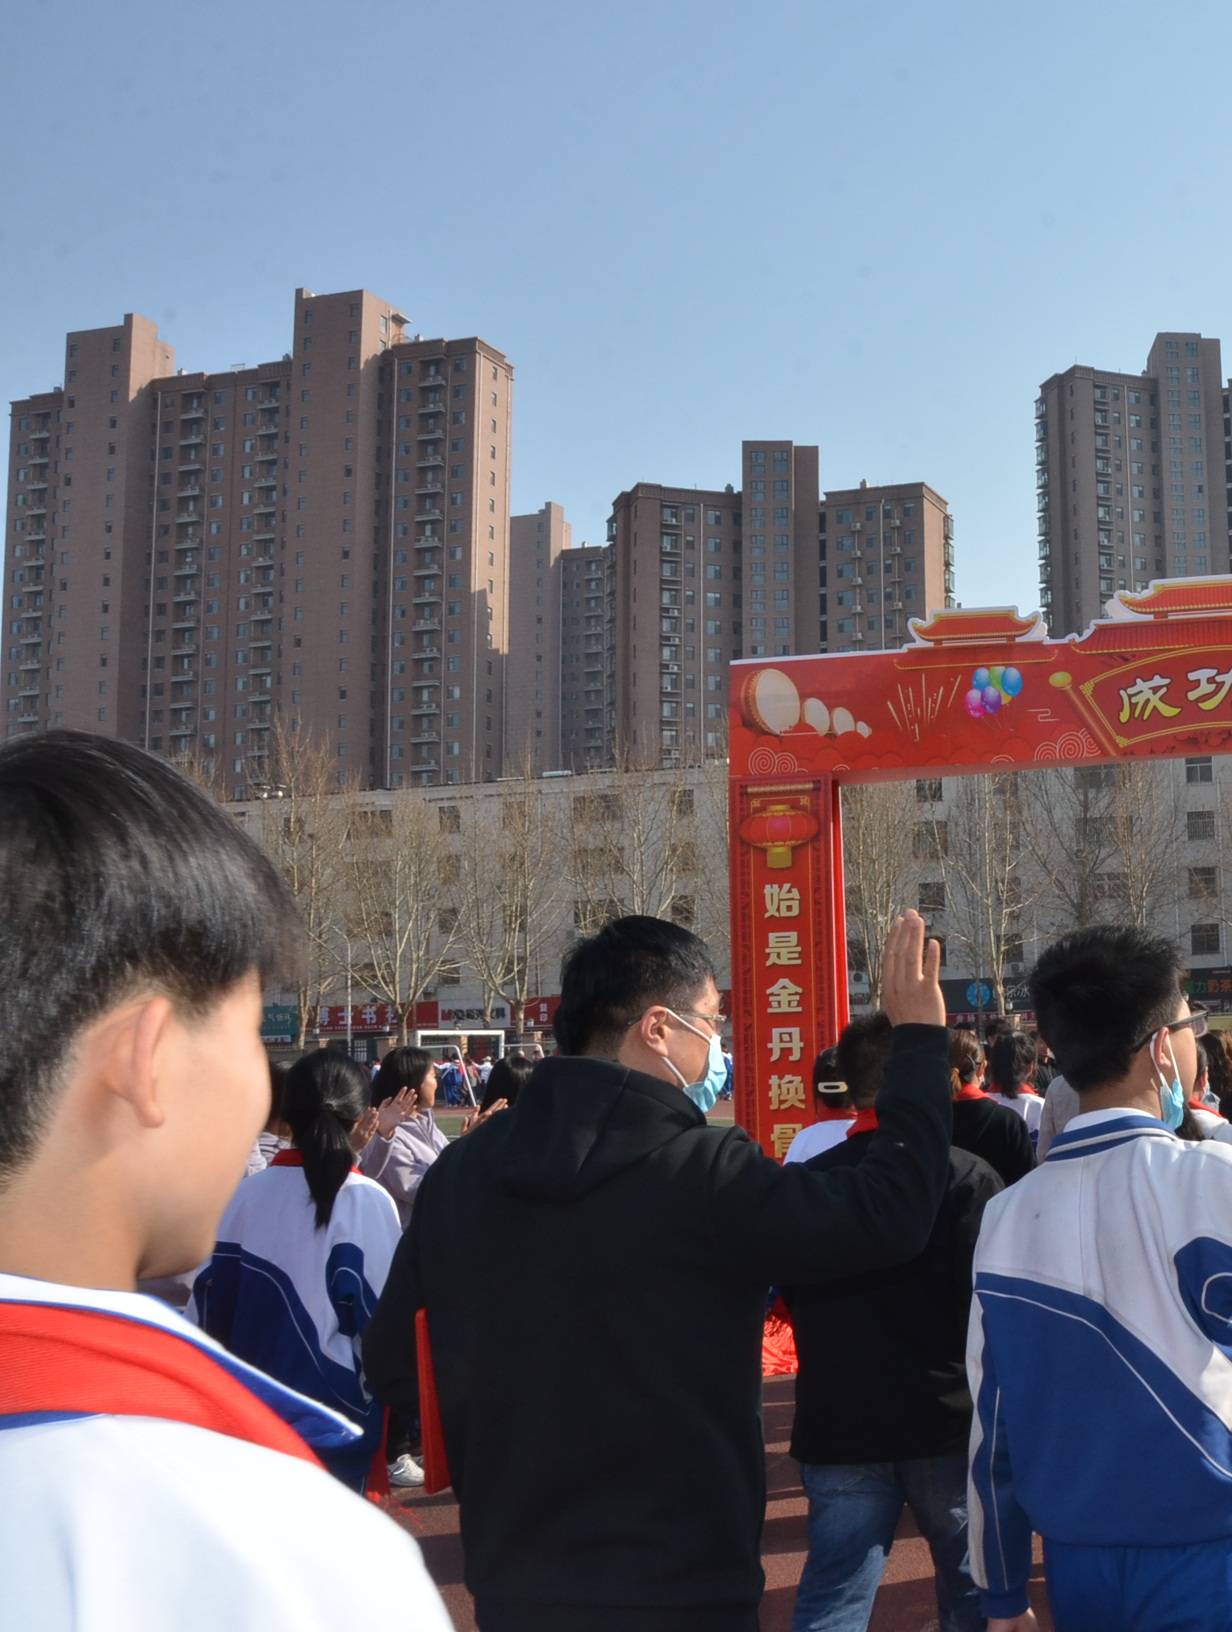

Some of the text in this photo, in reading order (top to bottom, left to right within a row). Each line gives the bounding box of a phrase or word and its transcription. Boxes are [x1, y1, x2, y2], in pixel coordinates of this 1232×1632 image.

[764, 882, 805, 1159] 始是金丹换骨
